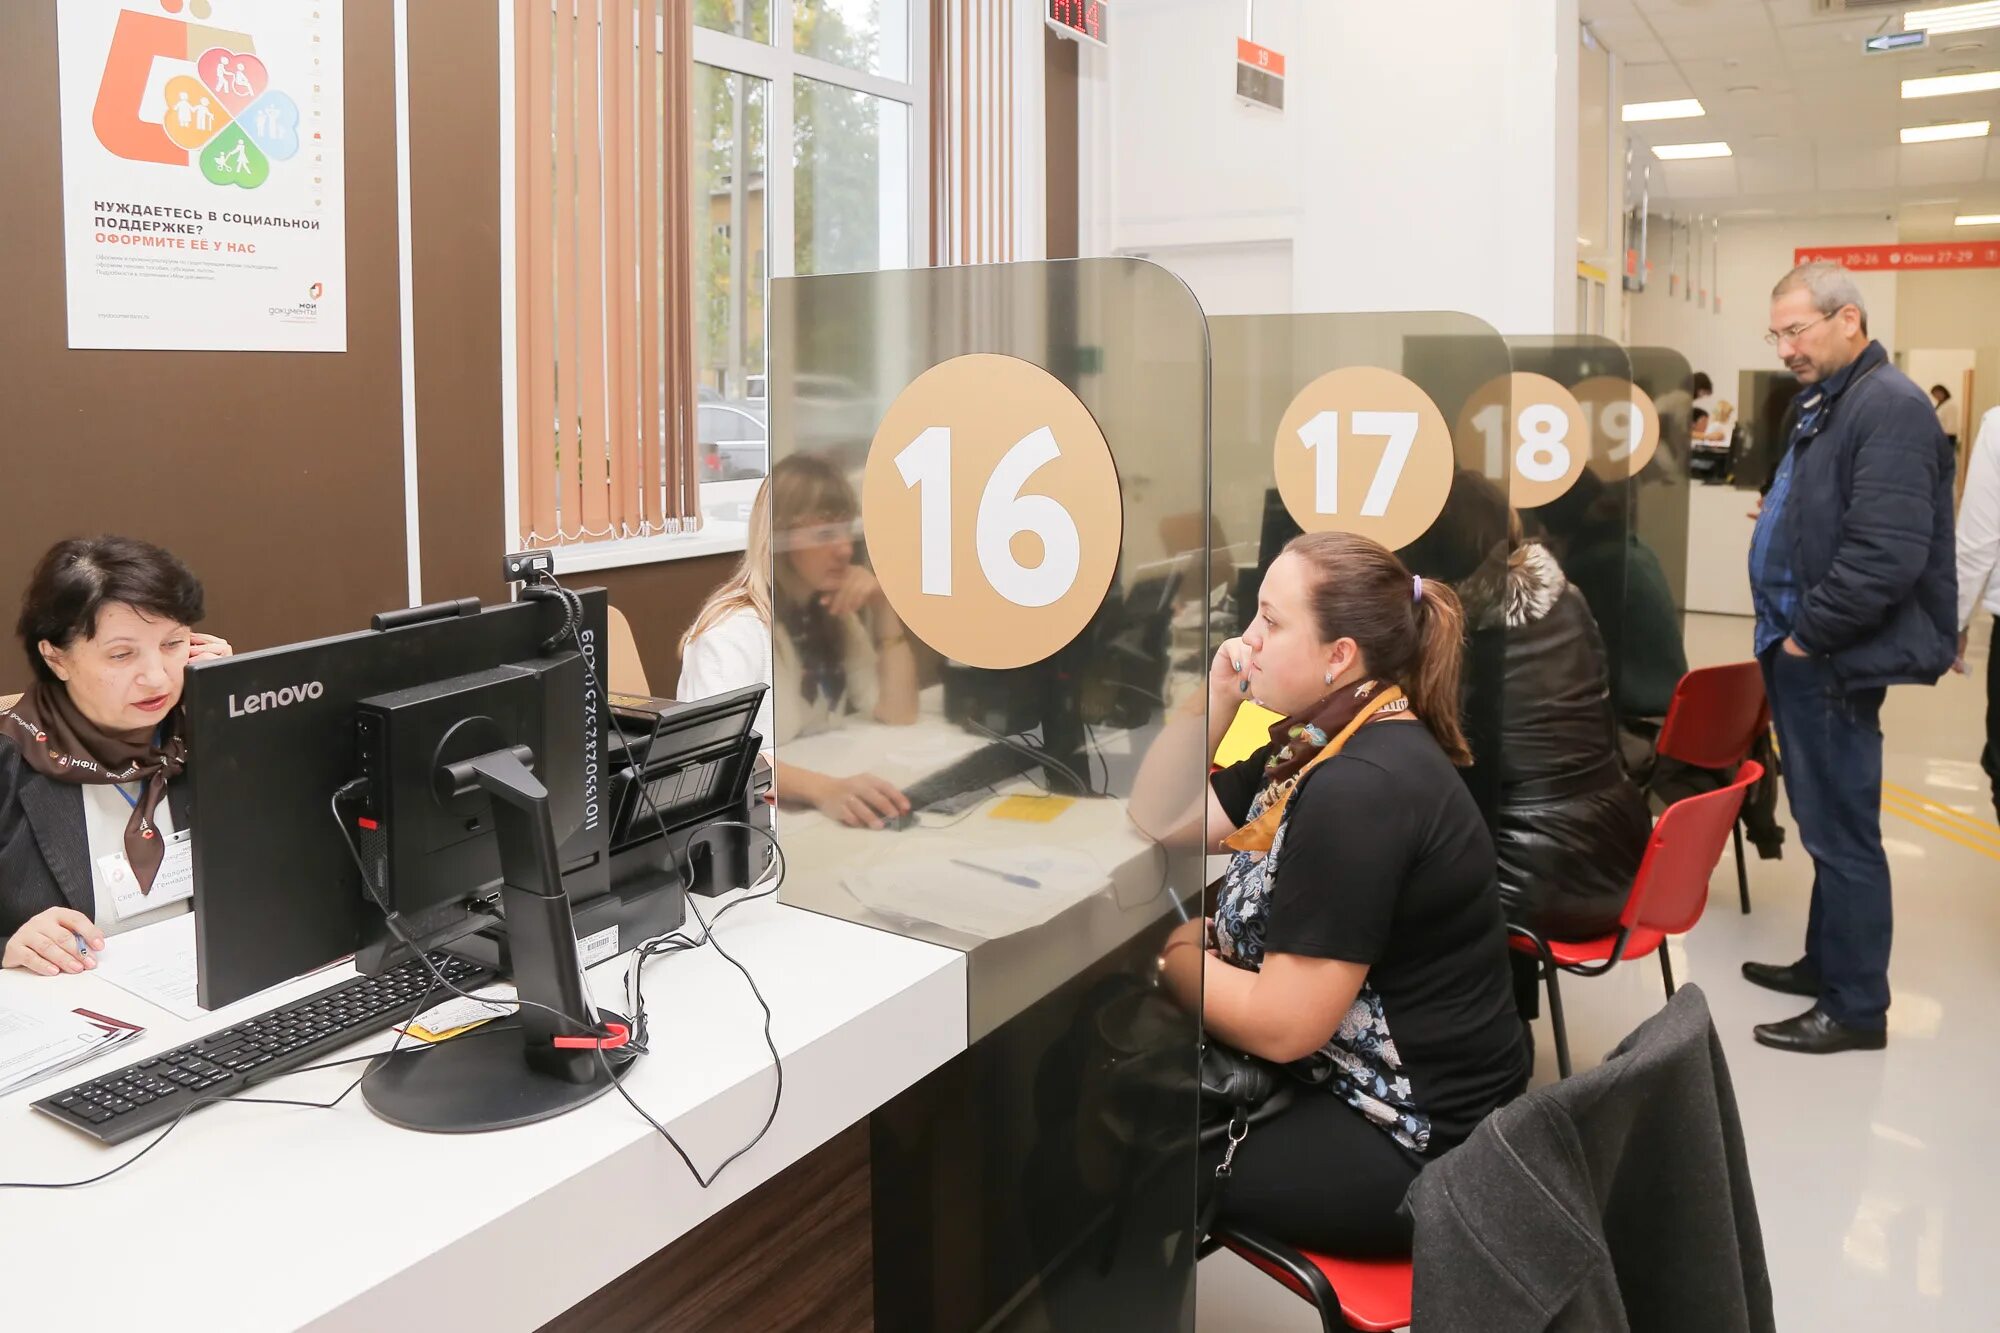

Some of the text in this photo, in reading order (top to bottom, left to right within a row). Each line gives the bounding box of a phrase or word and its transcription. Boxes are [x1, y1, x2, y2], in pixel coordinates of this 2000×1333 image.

[94, 200, 320, 230] НУЖДАЕТЕСЬ В СОЦИАЛЬНОЙ
[95, 217, 203, 235] ПОДДЕРЖКЕ?
[95, 232, 256, 254] ОФОРМИТЕ ЕЁ У НАС
[1471, 403, 1571, 482] 18
[1578, 400, 1644, 463] 19
[1296, 410, 1419, 517] 17
[893, 425, 1080, 608] 16
[229, 681, 324, 718] Lenovo
[71, 758, 98, 772] МФЦ
